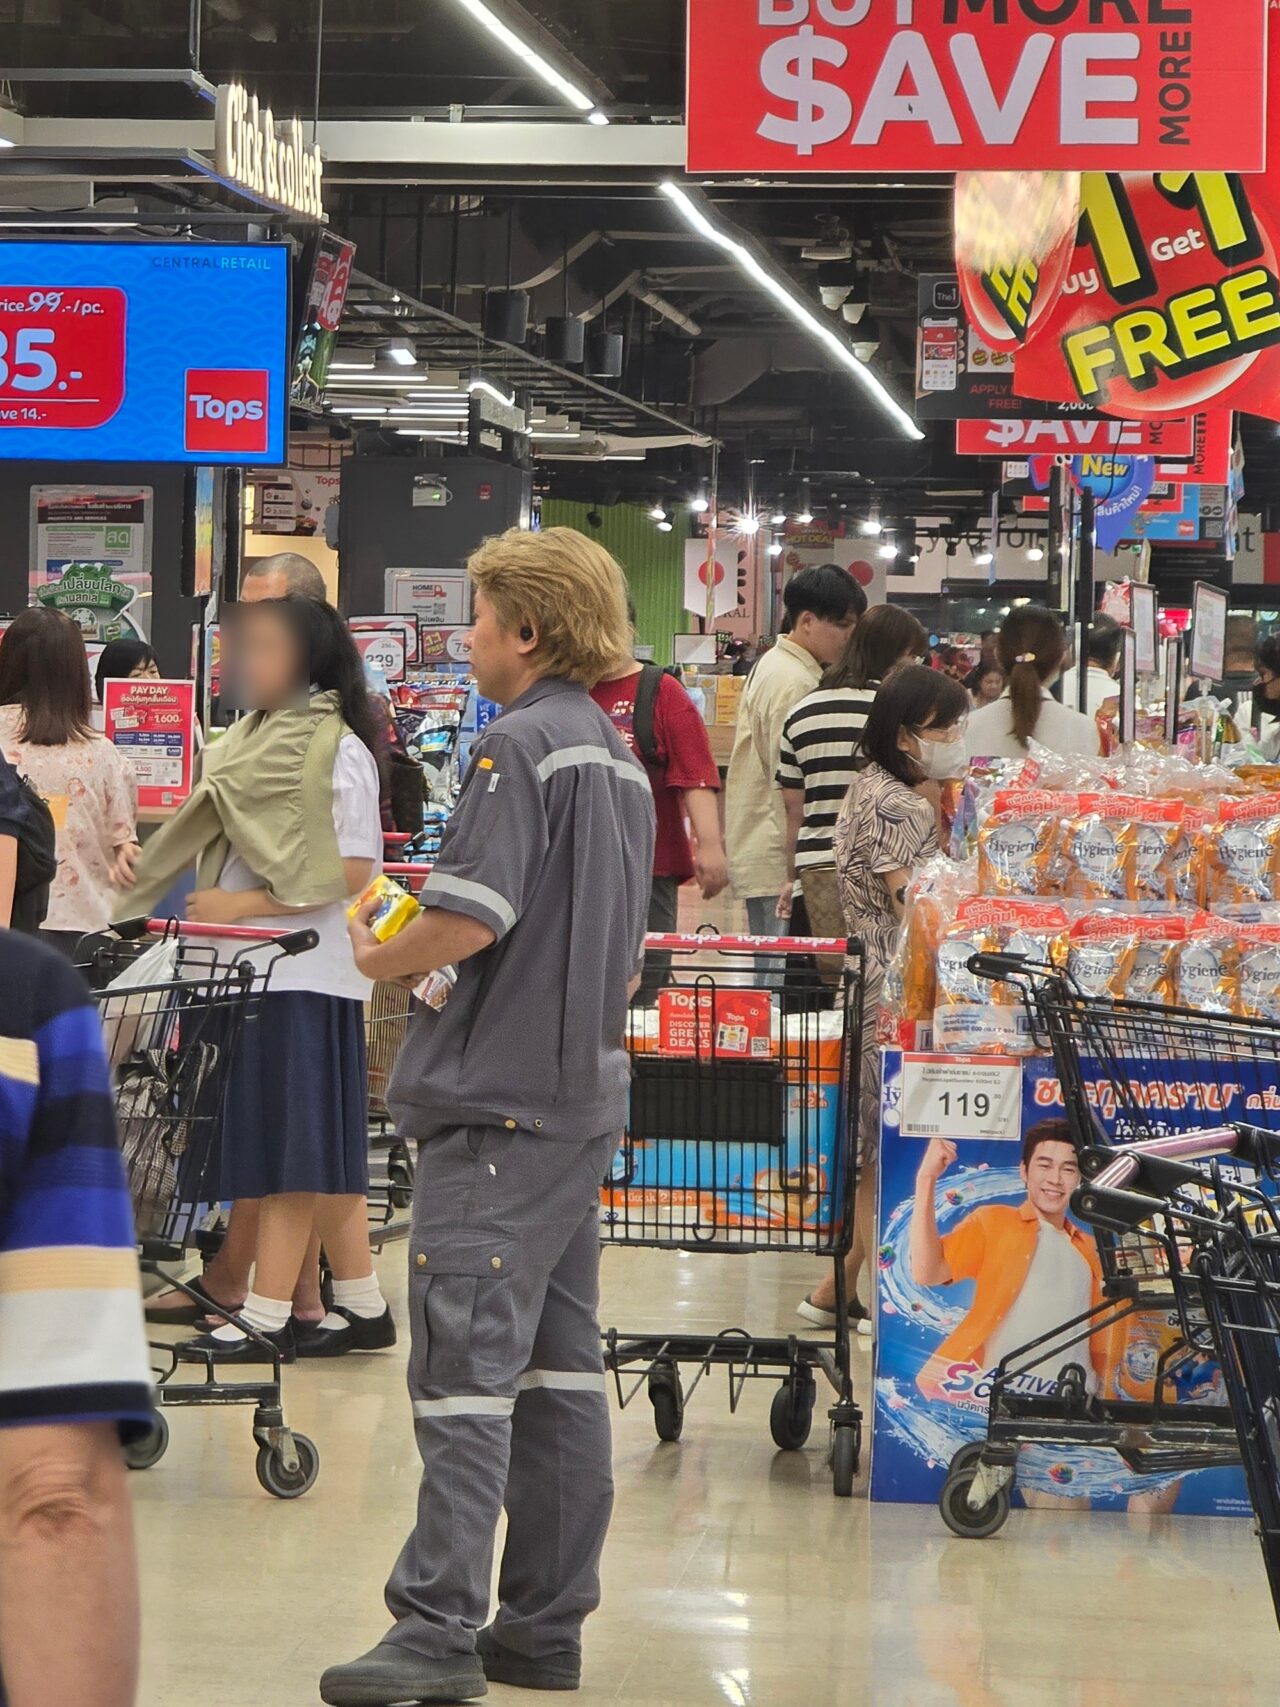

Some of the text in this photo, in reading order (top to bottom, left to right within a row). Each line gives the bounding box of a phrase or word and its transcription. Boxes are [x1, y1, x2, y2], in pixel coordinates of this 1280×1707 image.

[1158, 31, 1192, 146] MORE
[1060, 267, 1099, 295] uy
[1150, 228, 1206, 262] Get
[1065, 269, 1280, 397] FREE
[188, 393, 264, 426] Tops
[1081, 454, 1129, 478] New
[130, 686, 169, 695] PAY DAY
[988, 838, 1044, 856] Hygiene
[1073, 840, 1125, 857] Hygiene
[1135, 841, 1171, 857] giene
[1240, 964, 1280, 982] Hygien
[667, 992, 713, 1010] Tops
[669, 1028, 711, 1038] GREAT
[938, 1091, 991, 1118] 119
